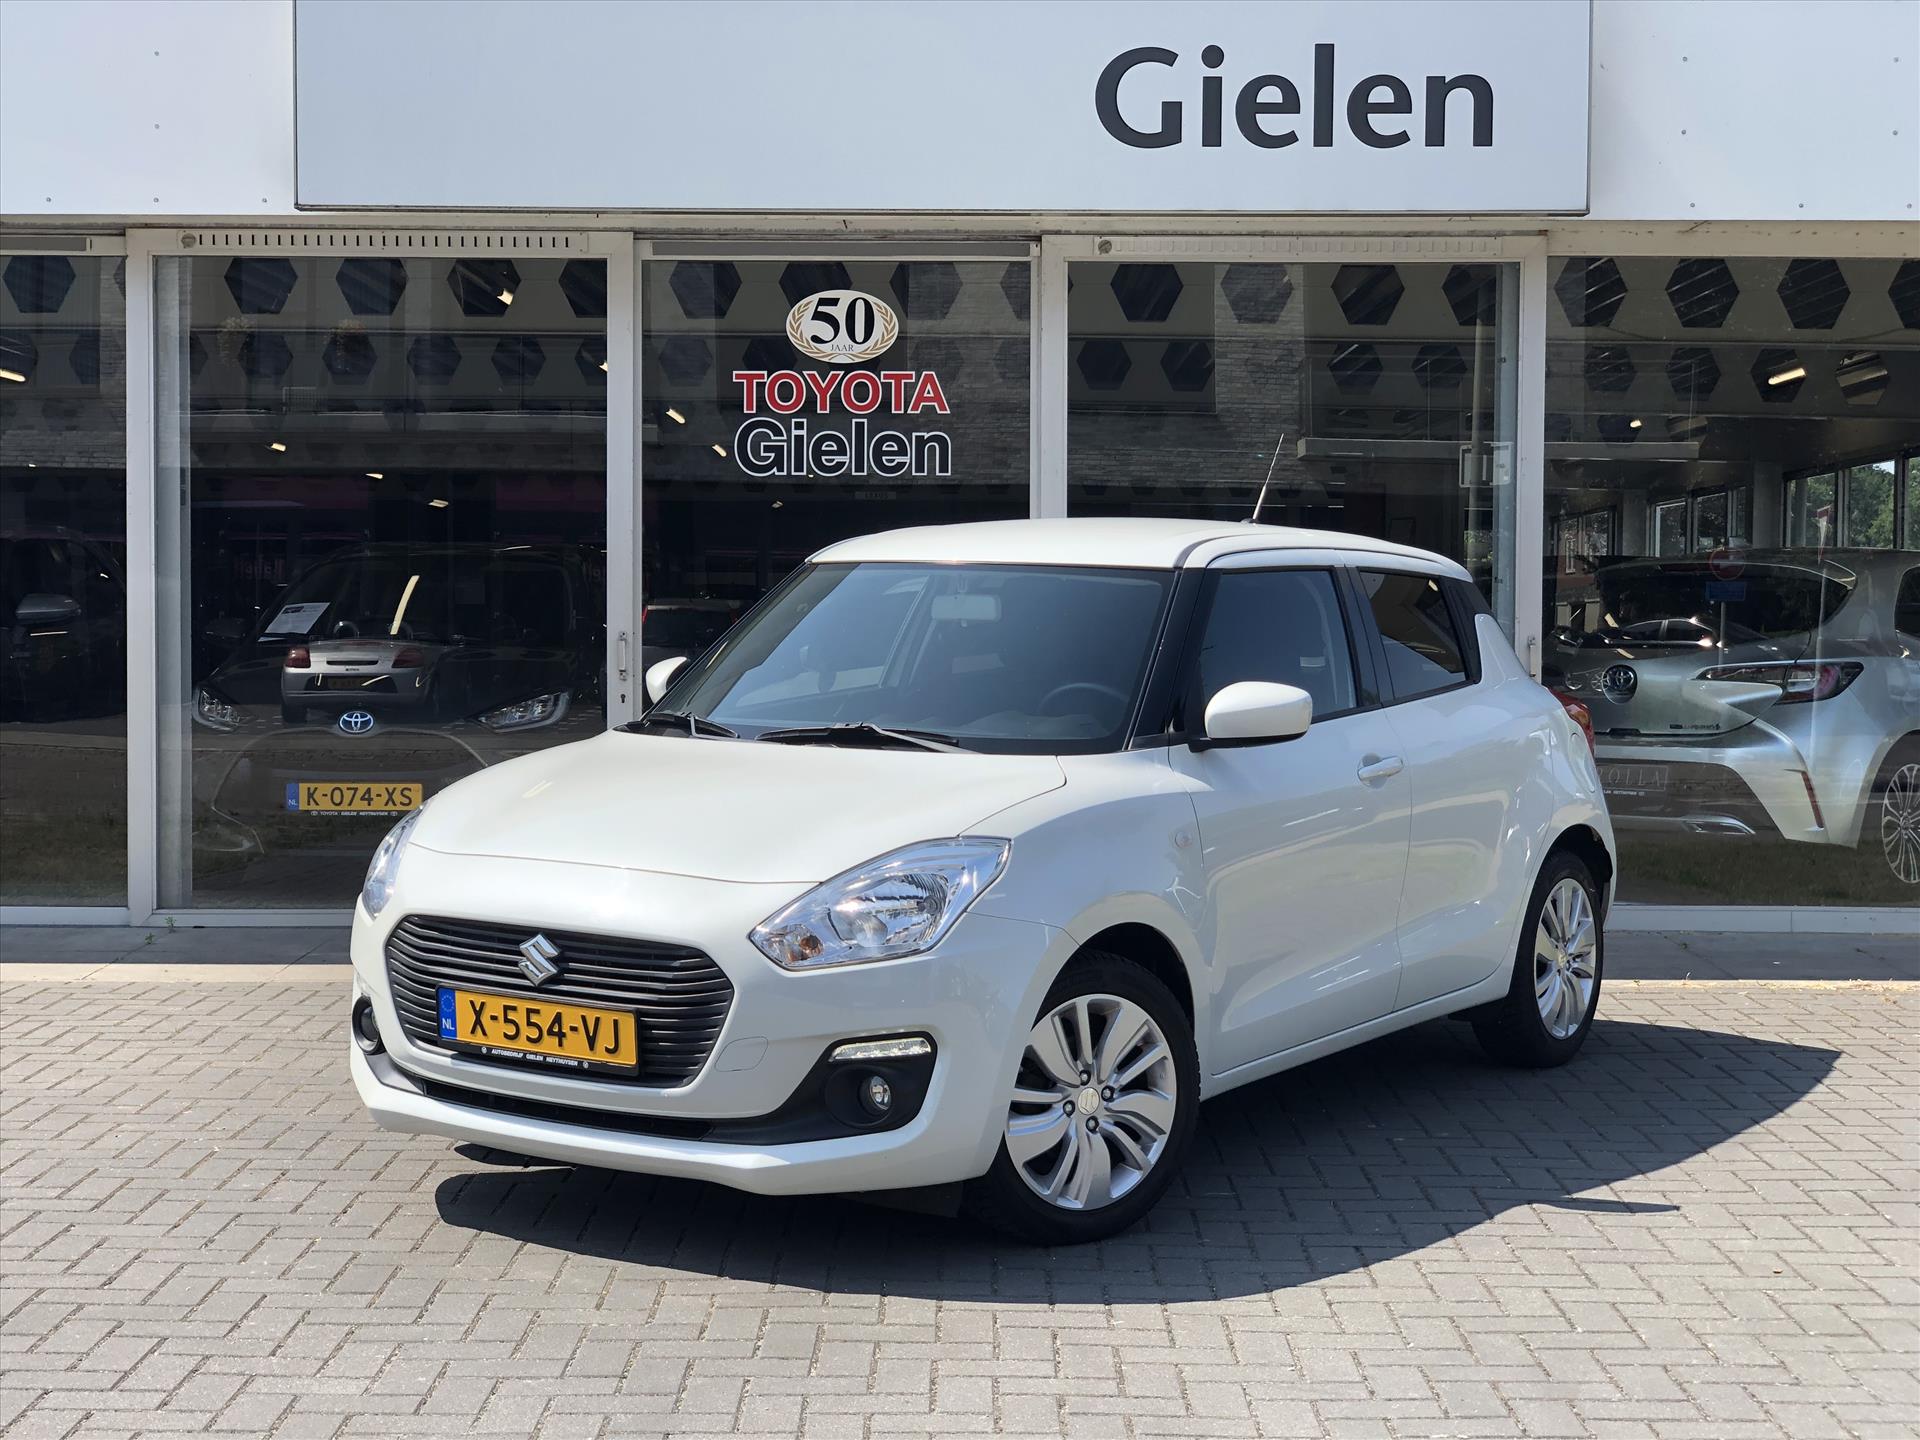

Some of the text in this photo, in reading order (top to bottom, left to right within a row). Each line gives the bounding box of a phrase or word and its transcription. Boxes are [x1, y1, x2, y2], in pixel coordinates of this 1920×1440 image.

[1095, 43, 1494, 149] Gielen
[810, 297, 875, 344] 50
[830, 344, 854, 352] JAAR
[733, 370, 951, 414] TOYOTA
[734, 417, 952, 477] Gielen
[306, 786, 412, 807] K-074-XS
[442, 999, 620, 1055] NL X-554-VJ
[491, 1048, 524, 1059] AUTOBEDRIJF
[526, 1053, 544, 1062] GIELEN
